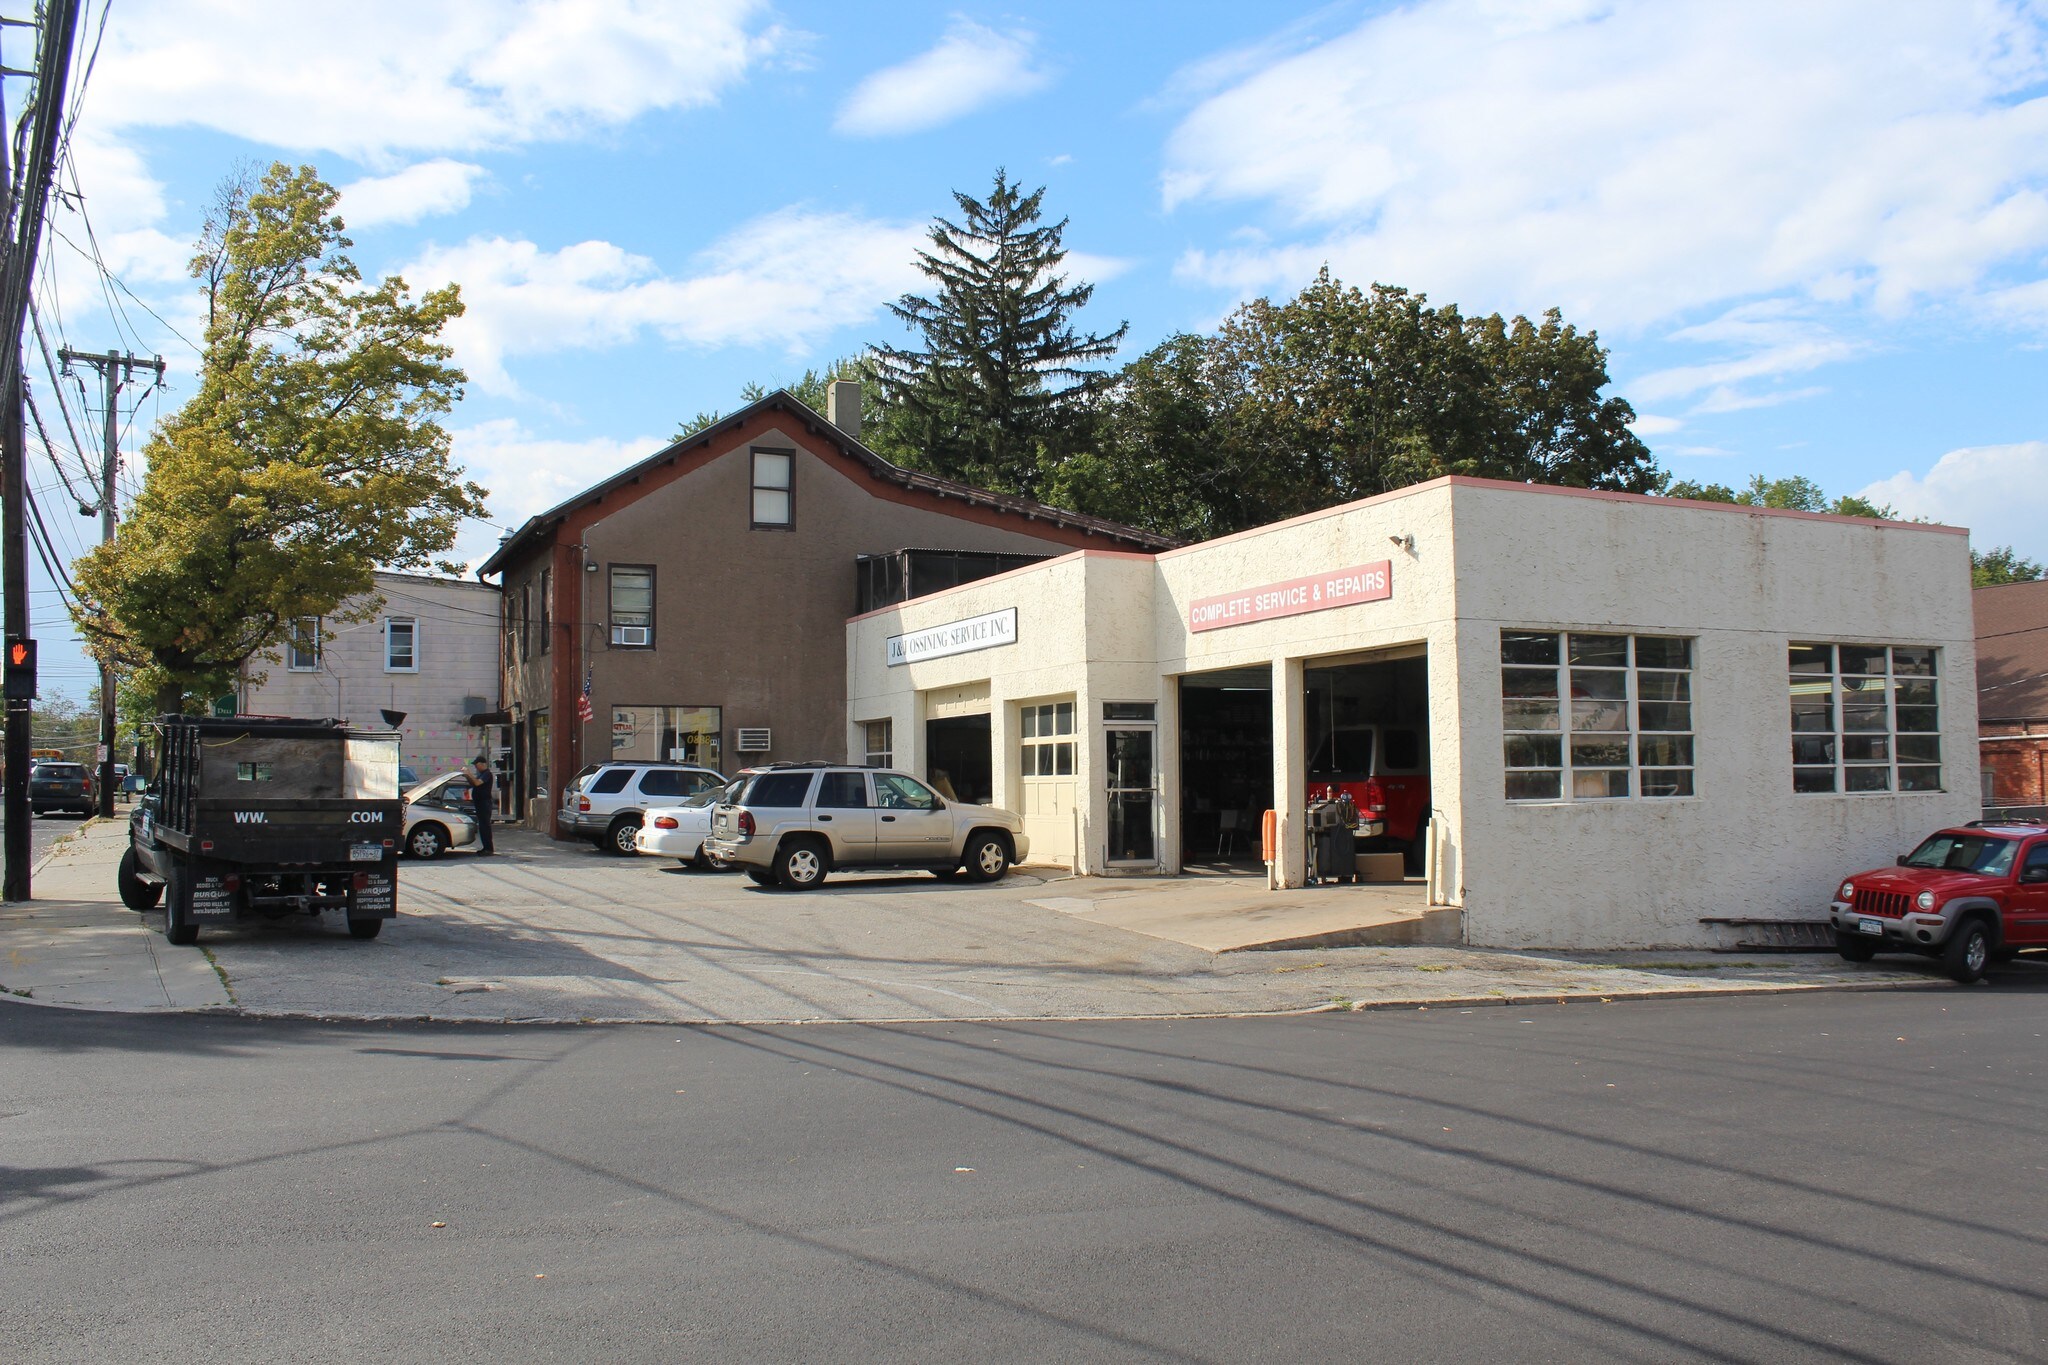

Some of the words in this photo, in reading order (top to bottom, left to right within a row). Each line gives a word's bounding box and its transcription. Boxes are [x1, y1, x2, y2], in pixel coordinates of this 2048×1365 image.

[1192, 597, 1250, 623] COMPLETE
[1256, 586, 1307, 612] SERVICE
[1313, 583, 1321, 601] &
[1327, 571, 1385, 599] REPAIRS
[910, 631, 948, 655] OSSINING
[951, 622, 987, 646] SERVICE
[990, 616, 1010, 637] INC.
[347, 811, 383, 823] .COM
